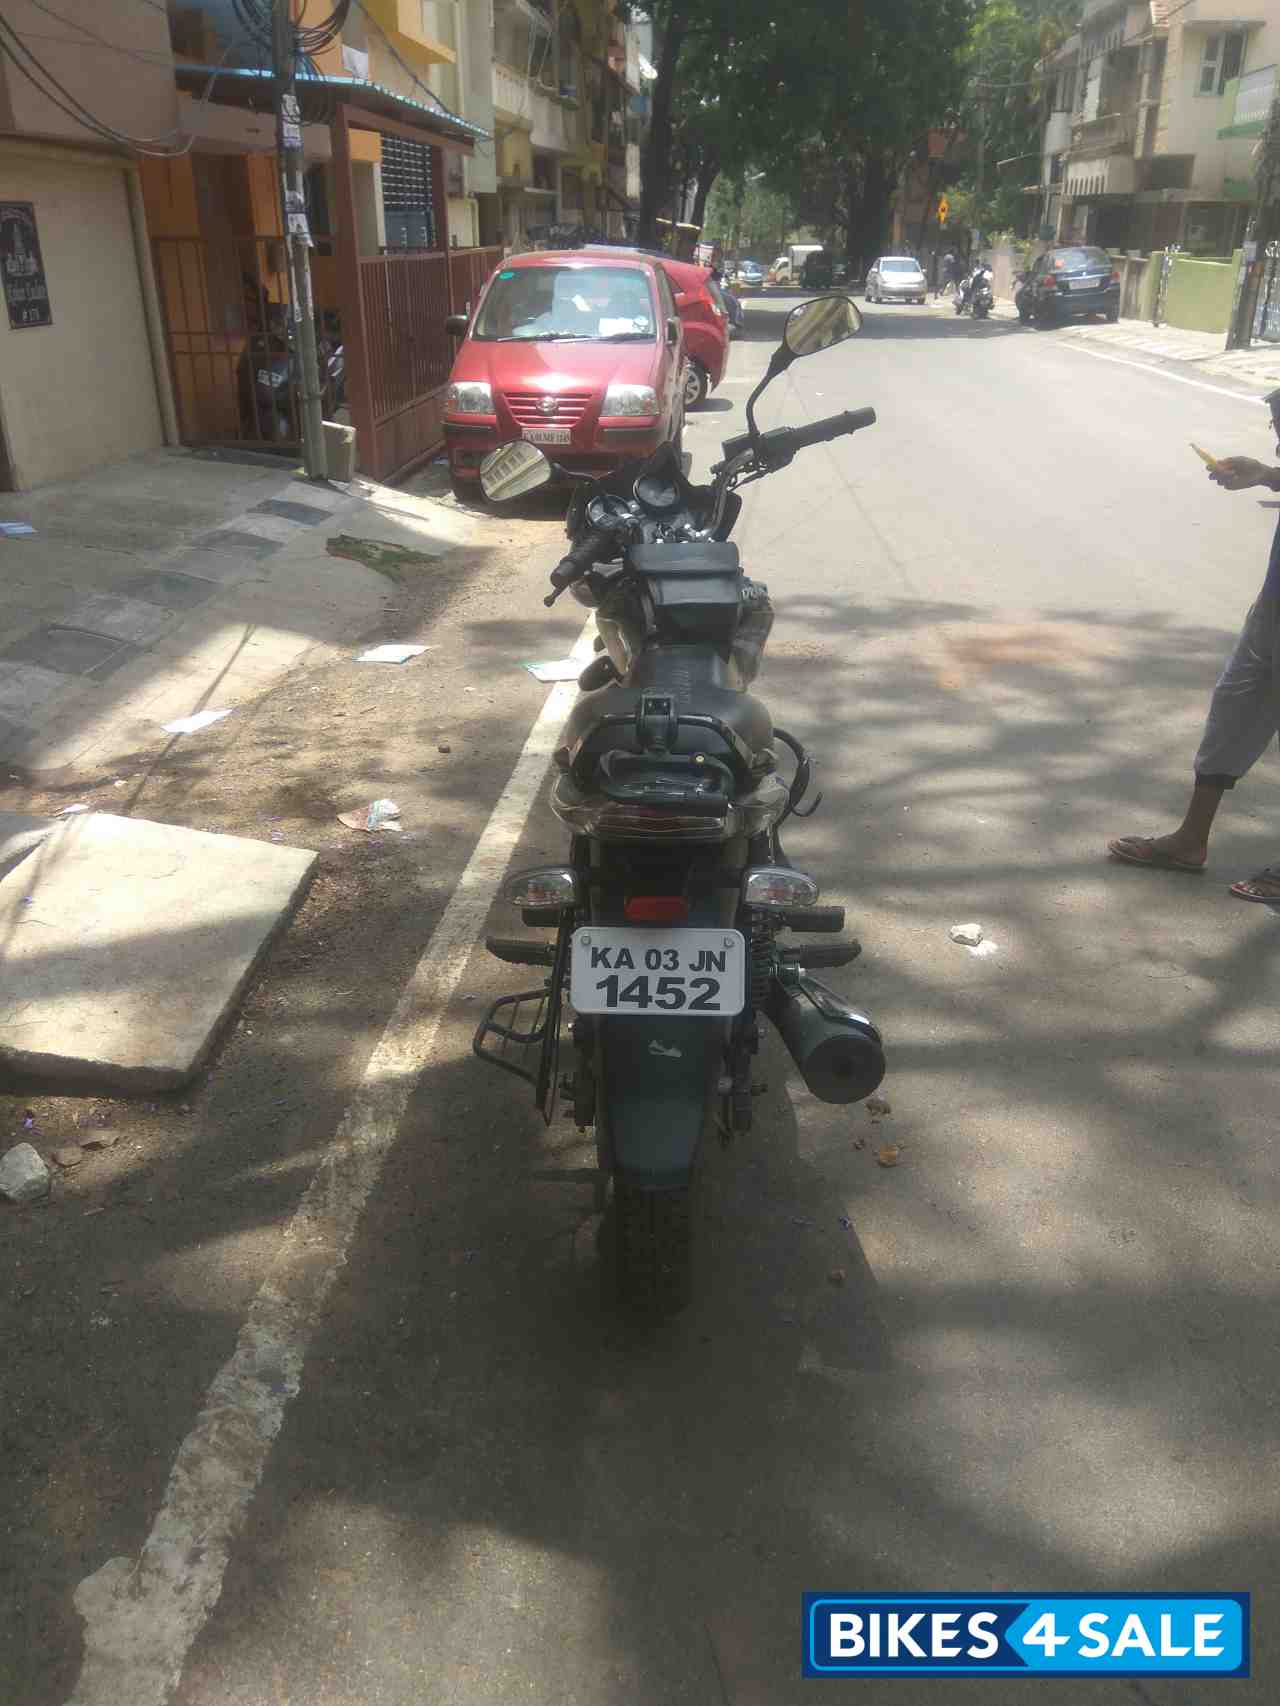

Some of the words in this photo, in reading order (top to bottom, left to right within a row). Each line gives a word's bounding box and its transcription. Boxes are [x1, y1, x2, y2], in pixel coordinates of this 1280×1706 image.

[590, 946, 635, 970] KA
[644, 948, 680, 971] 03
[688, 950, 726, 973] JN
[595, 974, 721, 1011] 1452
